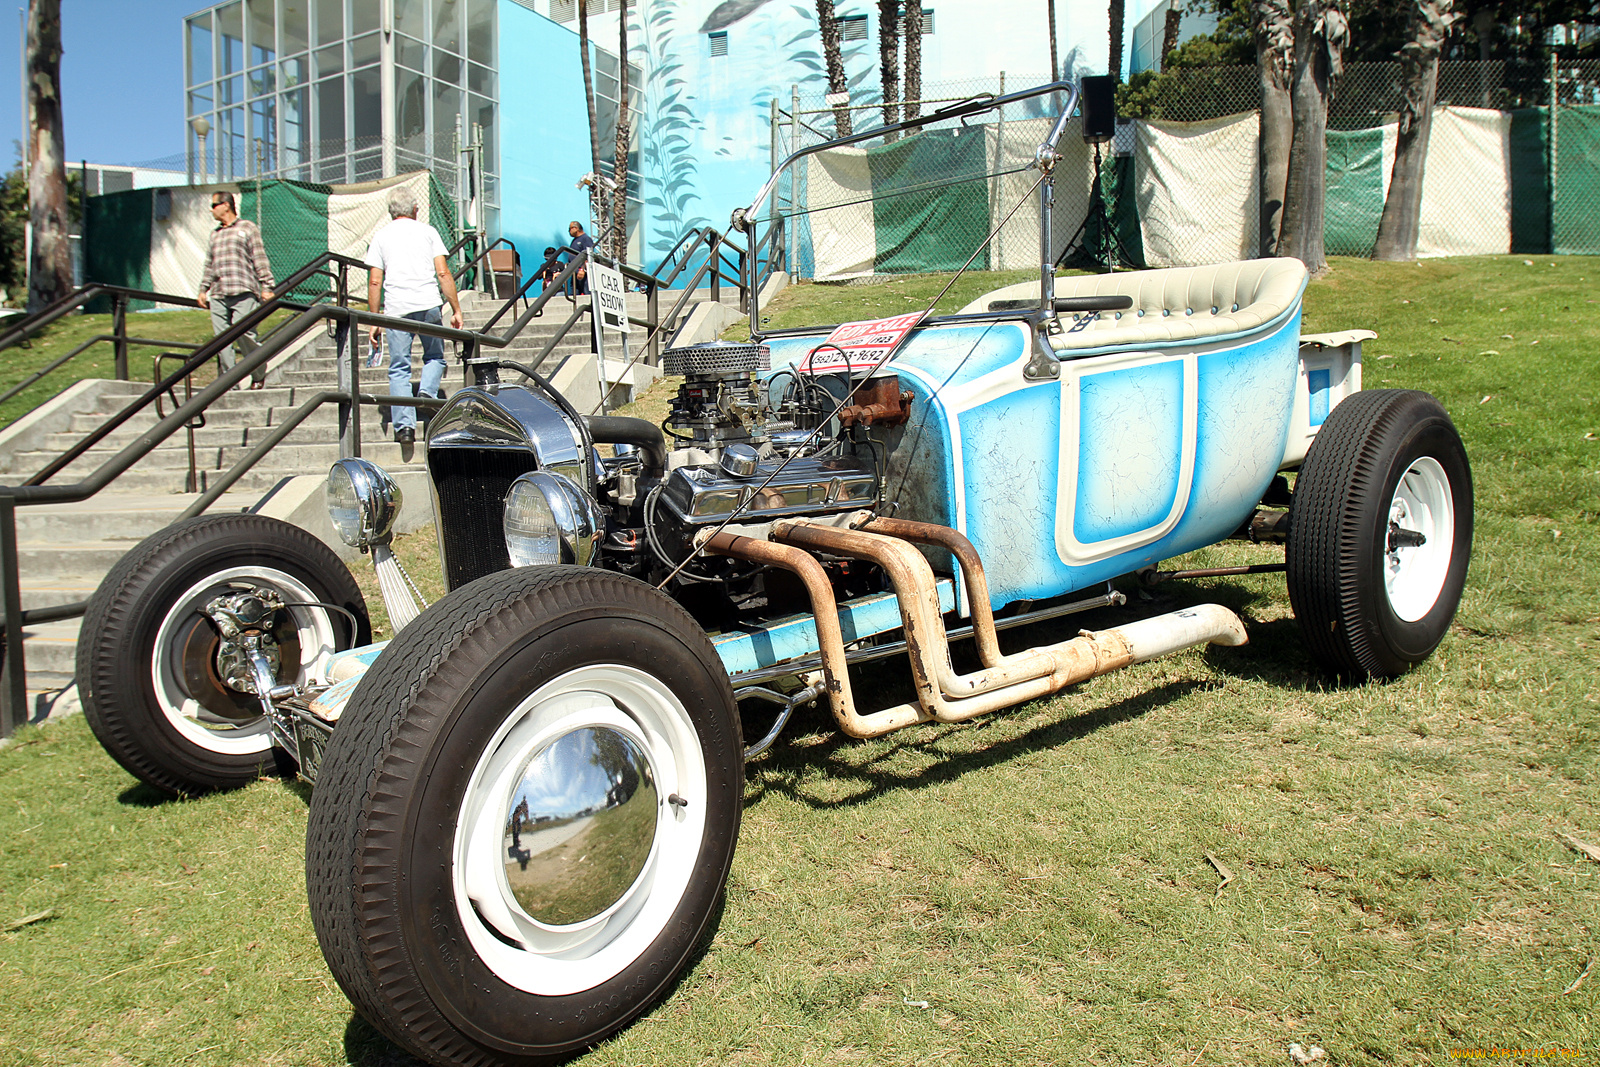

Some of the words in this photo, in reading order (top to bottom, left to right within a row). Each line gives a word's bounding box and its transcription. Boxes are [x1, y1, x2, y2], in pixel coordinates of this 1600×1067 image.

[601, 273, 620, 293] CAR
[600, 291, 624, 312] SHOW
[831, 325, 873, 341] FOR
[868, 315, 920, 334] SALE
[869, 335, 893, 344] 1923
